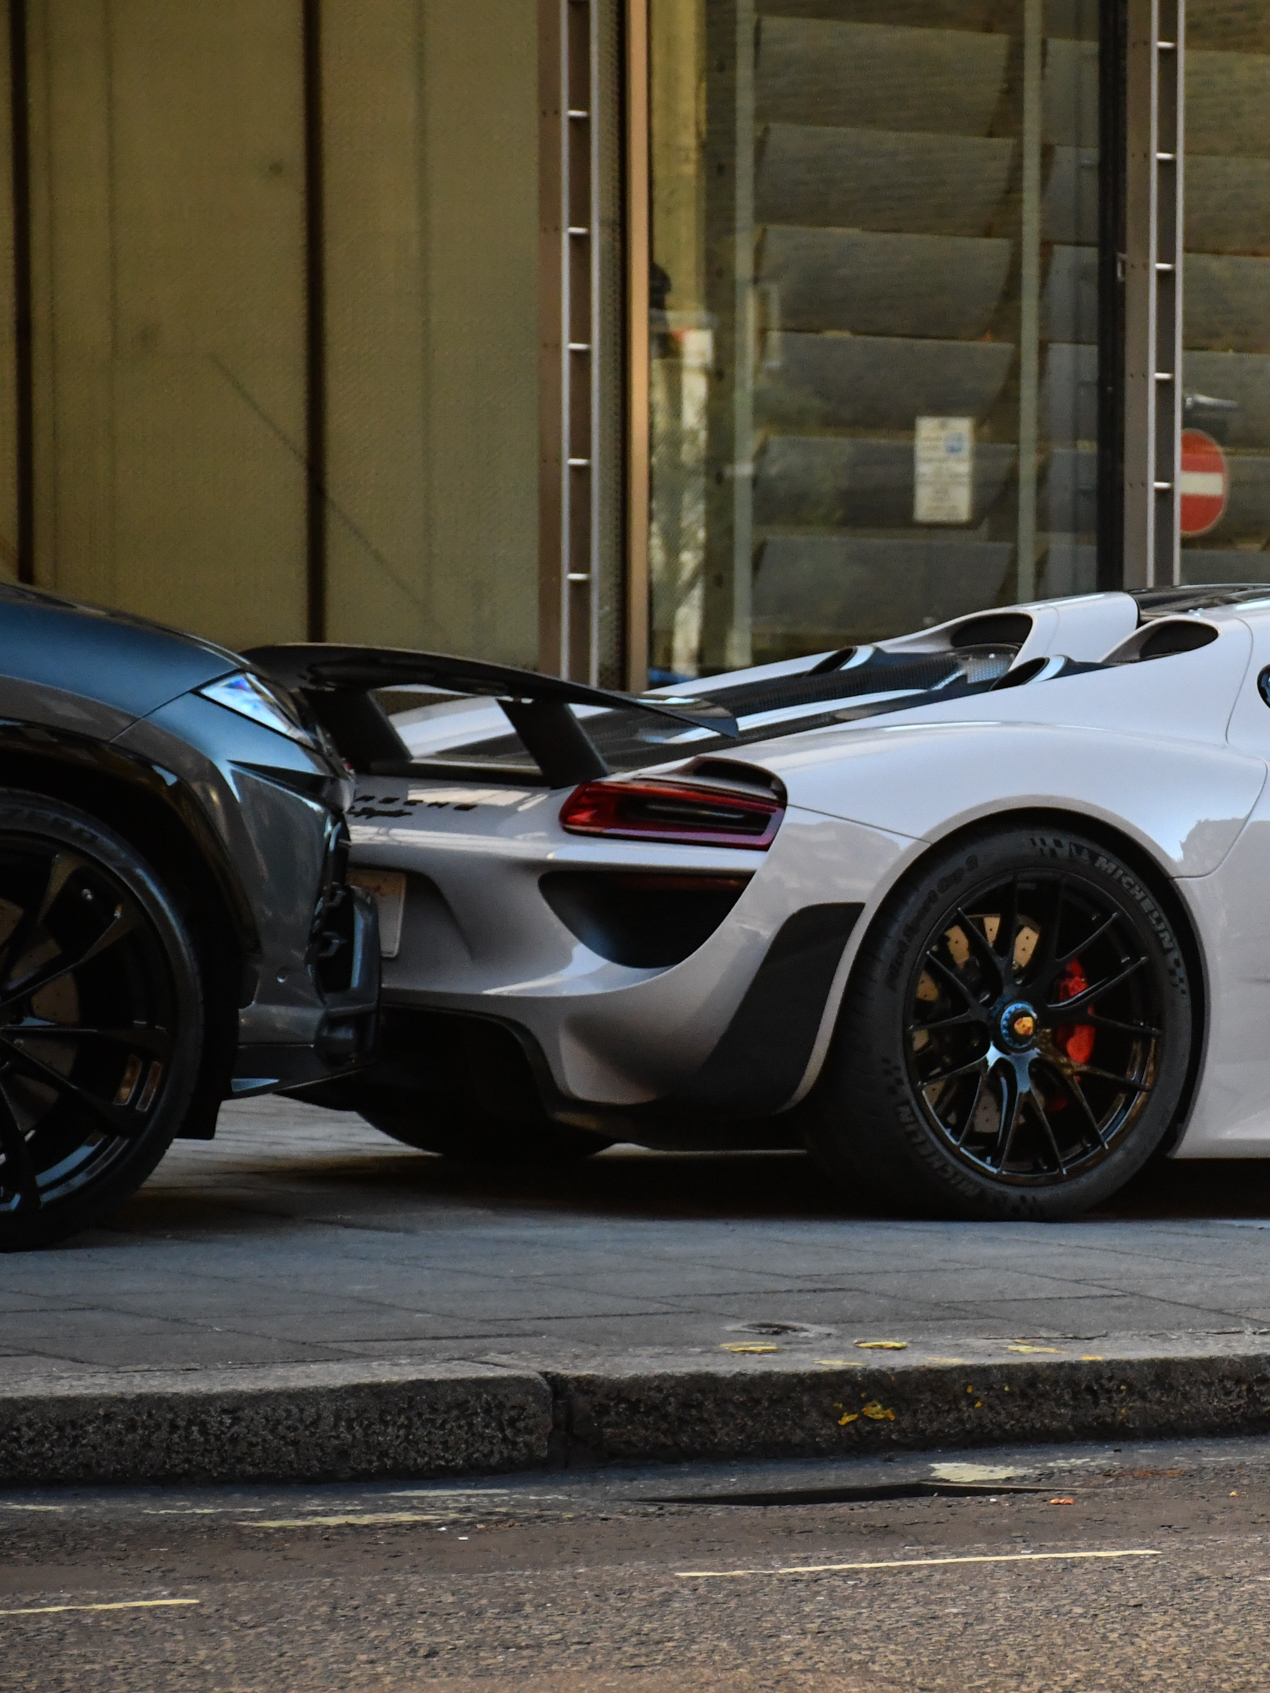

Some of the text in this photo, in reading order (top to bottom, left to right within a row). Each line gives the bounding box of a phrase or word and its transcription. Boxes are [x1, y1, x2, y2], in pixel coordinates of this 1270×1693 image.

[933, 862, 967, 897] Cup
[963, 853, 980, 873] 2
[1093, 852, 1174, 951] MICHELIN
